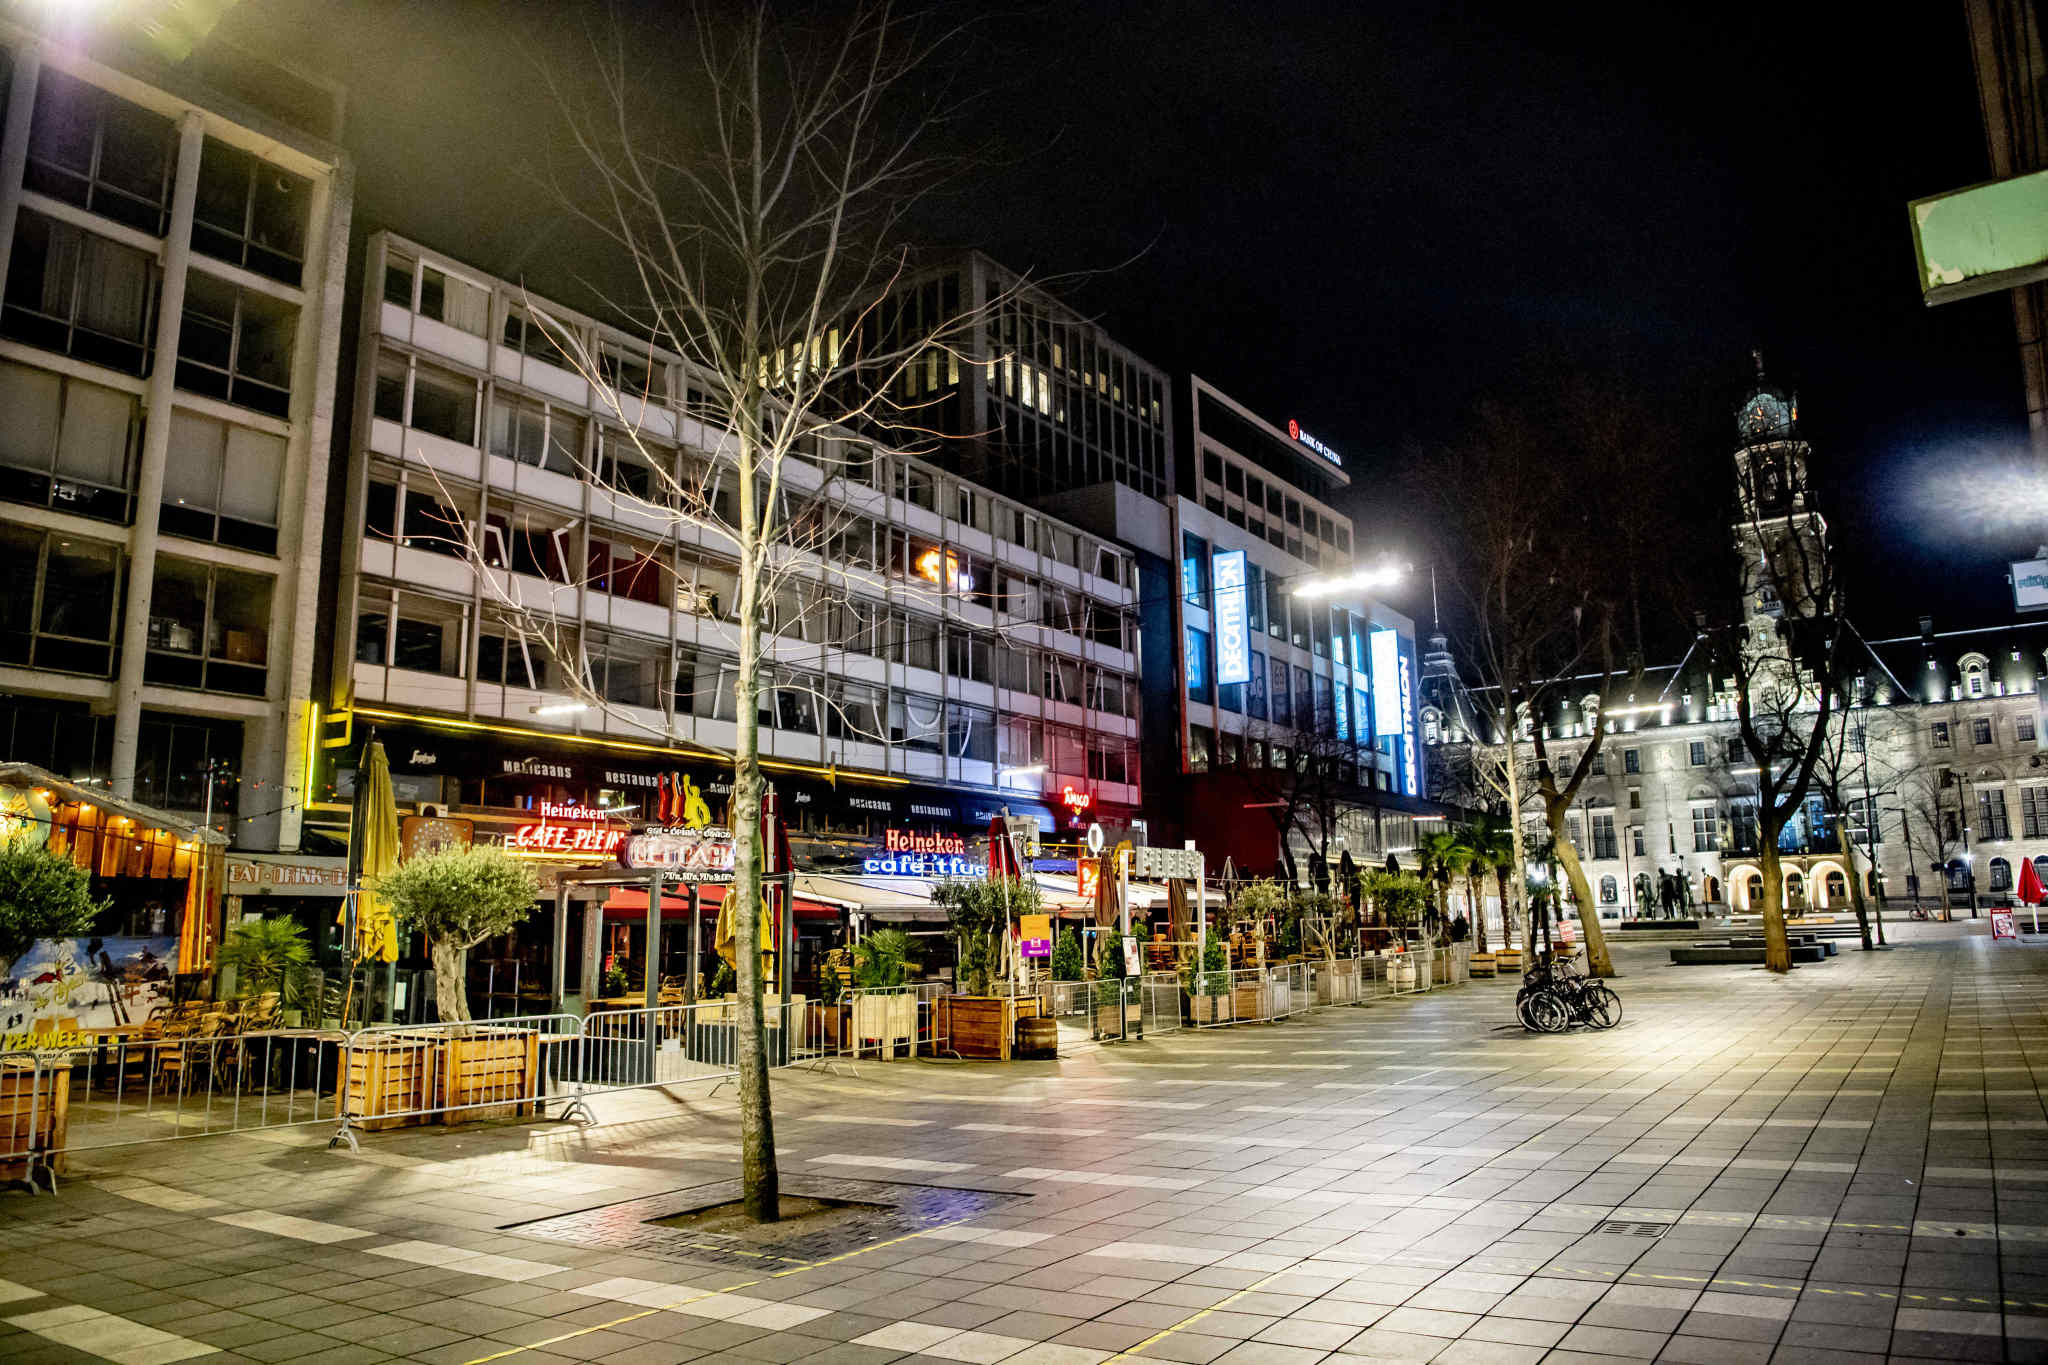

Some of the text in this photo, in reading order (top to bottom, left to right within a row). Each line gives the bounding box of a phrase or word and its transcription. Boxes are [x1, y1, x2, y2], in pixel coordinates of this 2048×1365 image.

[1219, 558, 1243, 677] DECATHLON
[541, 801, 607, 820] Heineken
[886, 829, 965, 855] Heineken
[229, 864, 263, 883] EAT
[272, 865, 323, 886] DRINK
